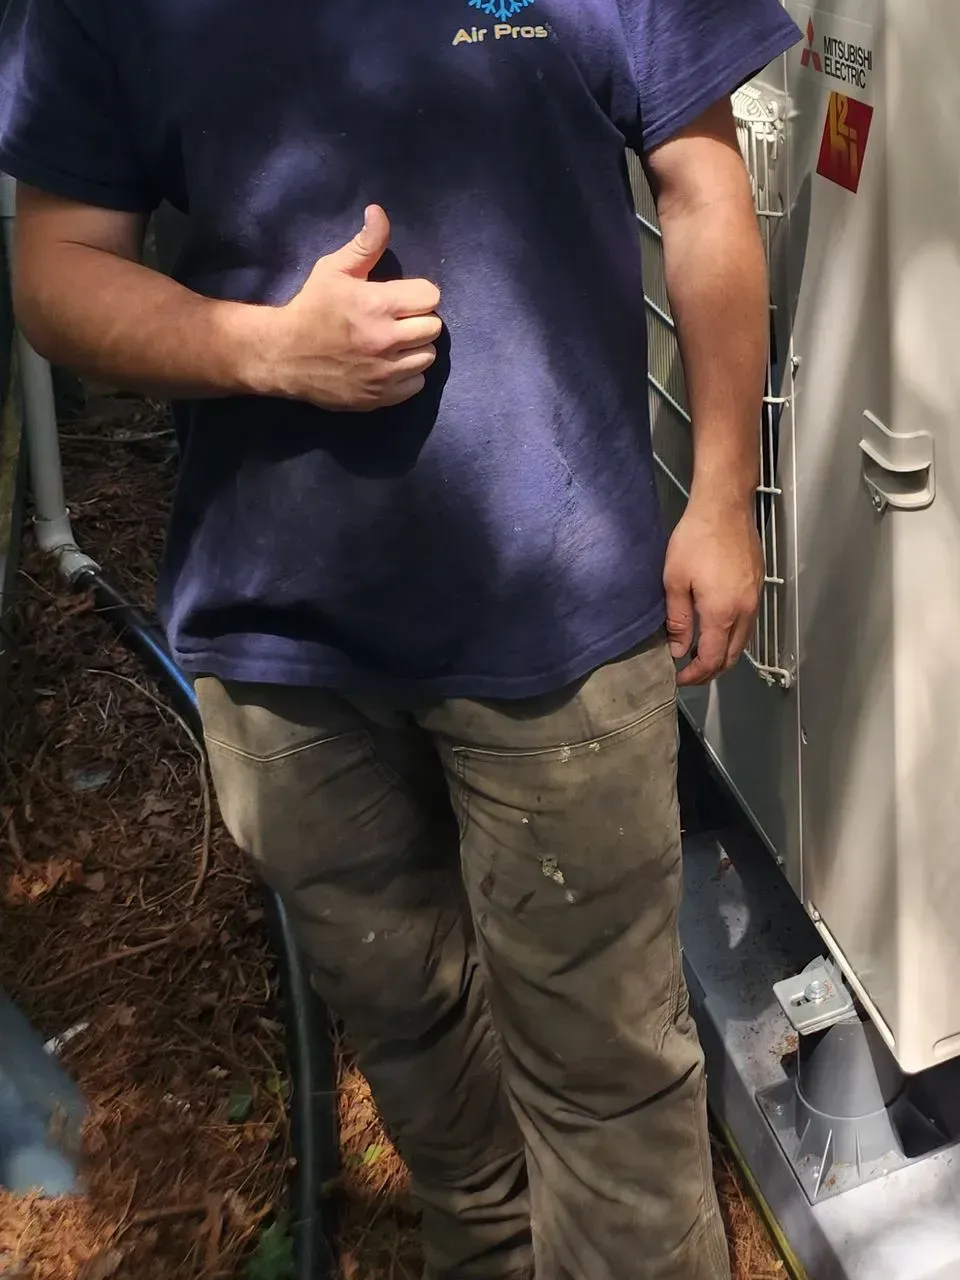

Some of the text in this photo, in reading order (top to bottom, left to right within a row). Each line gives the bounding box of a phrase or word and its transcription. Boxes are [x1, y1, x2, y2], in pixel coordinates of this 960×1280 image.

[452, 24, 548, 46] Air Pros
[823, 35, 873, 71] MITSUBISHI
[824, 56, 866, 89] ELECTRIC
